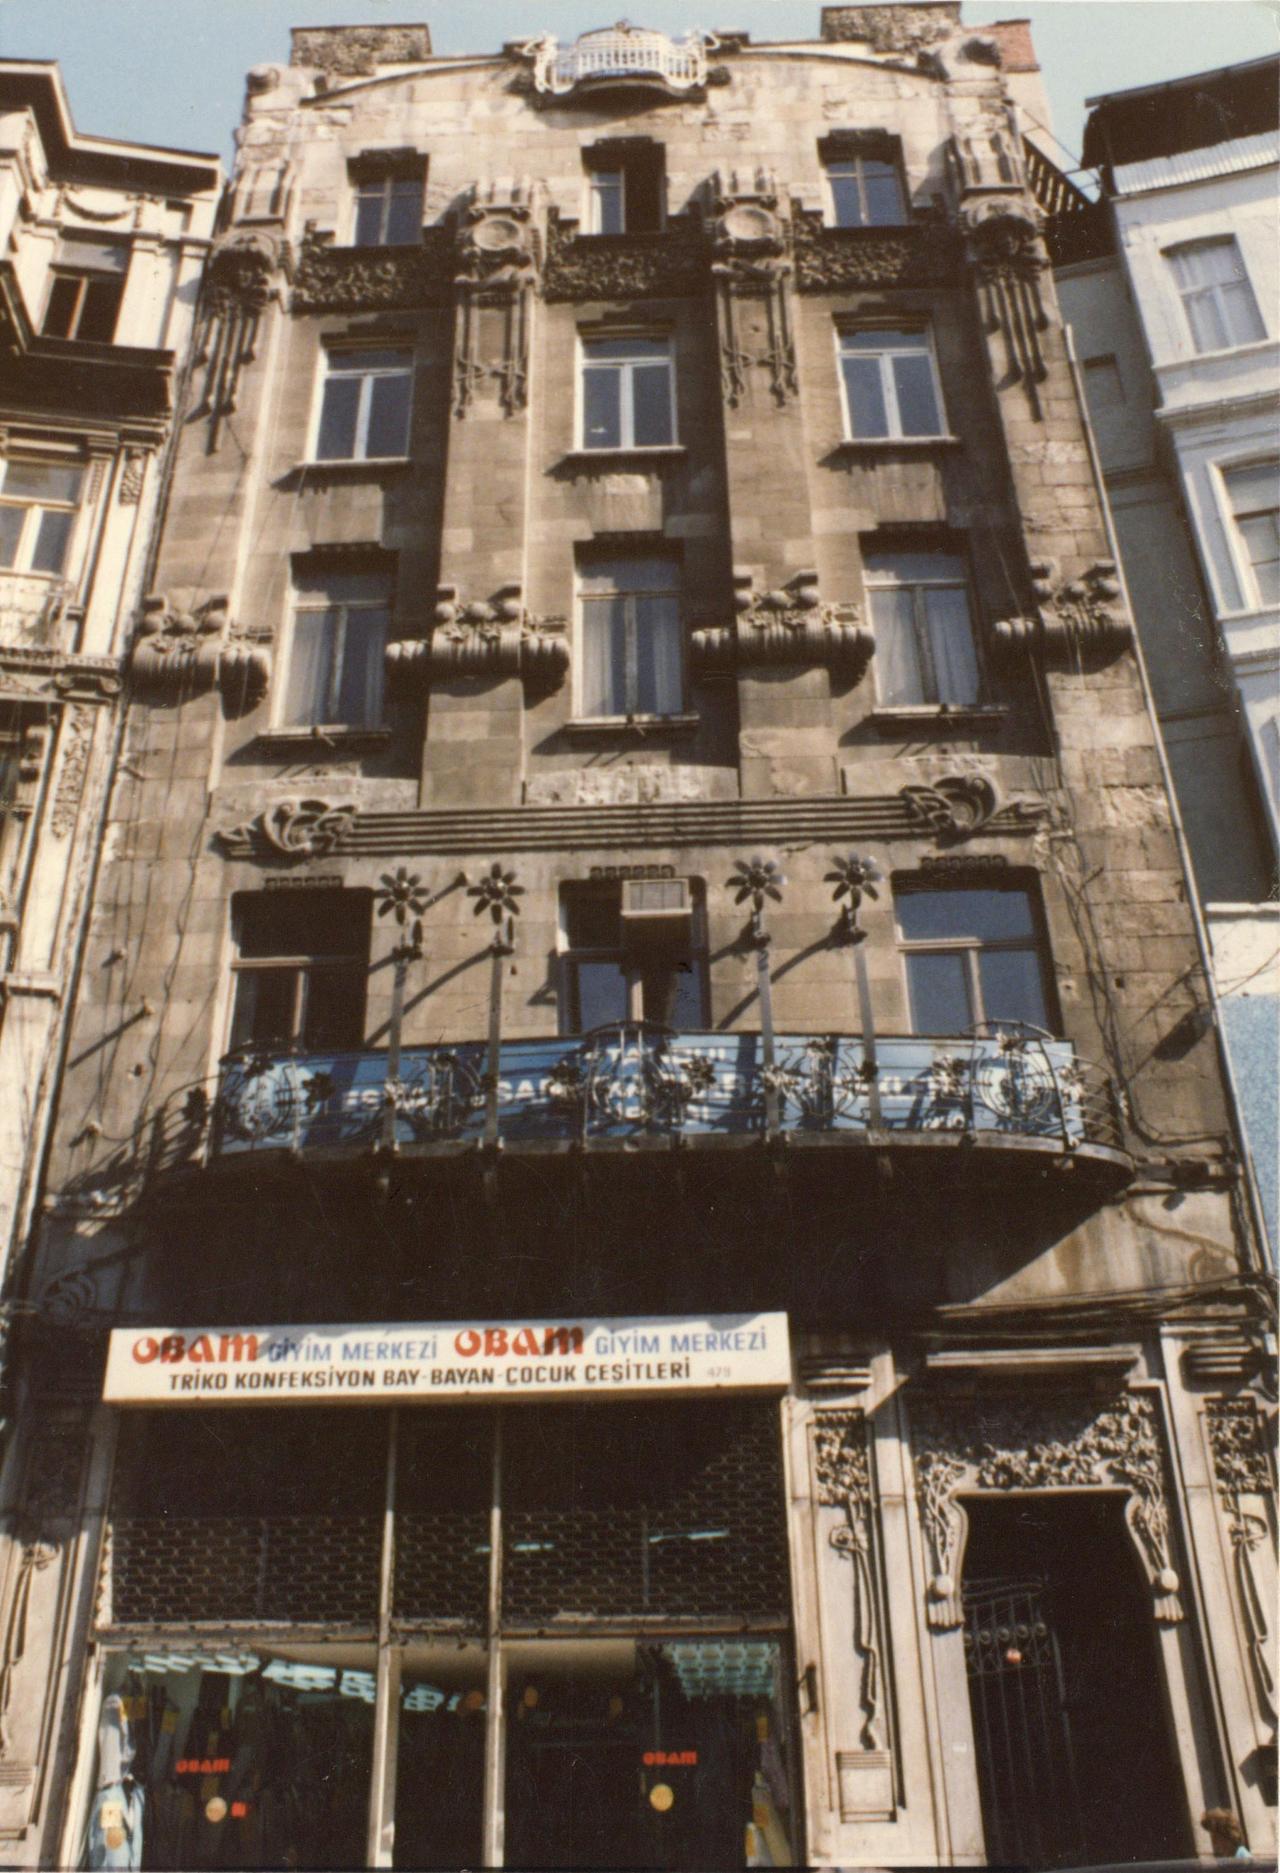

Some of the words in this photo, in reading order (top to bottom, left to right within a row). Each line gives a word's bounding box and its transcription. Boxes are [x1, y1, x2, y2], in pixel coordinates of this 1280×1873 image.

[131, 1333, 259, 1364] OBAM
[268, 1337, 331, 1362] GİYİM
[342, 1334, 437, 1361] MERKEZİ
[453, 1326, 584, 1357] OBAM
[595, 1330, 660, 1355] GİYİM
[670, 1326, 767, 1353] MERKEZİ
[169, 1368, 228, 1391] TRİKO
[234, 1365, 375, 1389] KONFEKSİYON
[584, 1356, 690, 1383] ÇEŞİTLERİ
